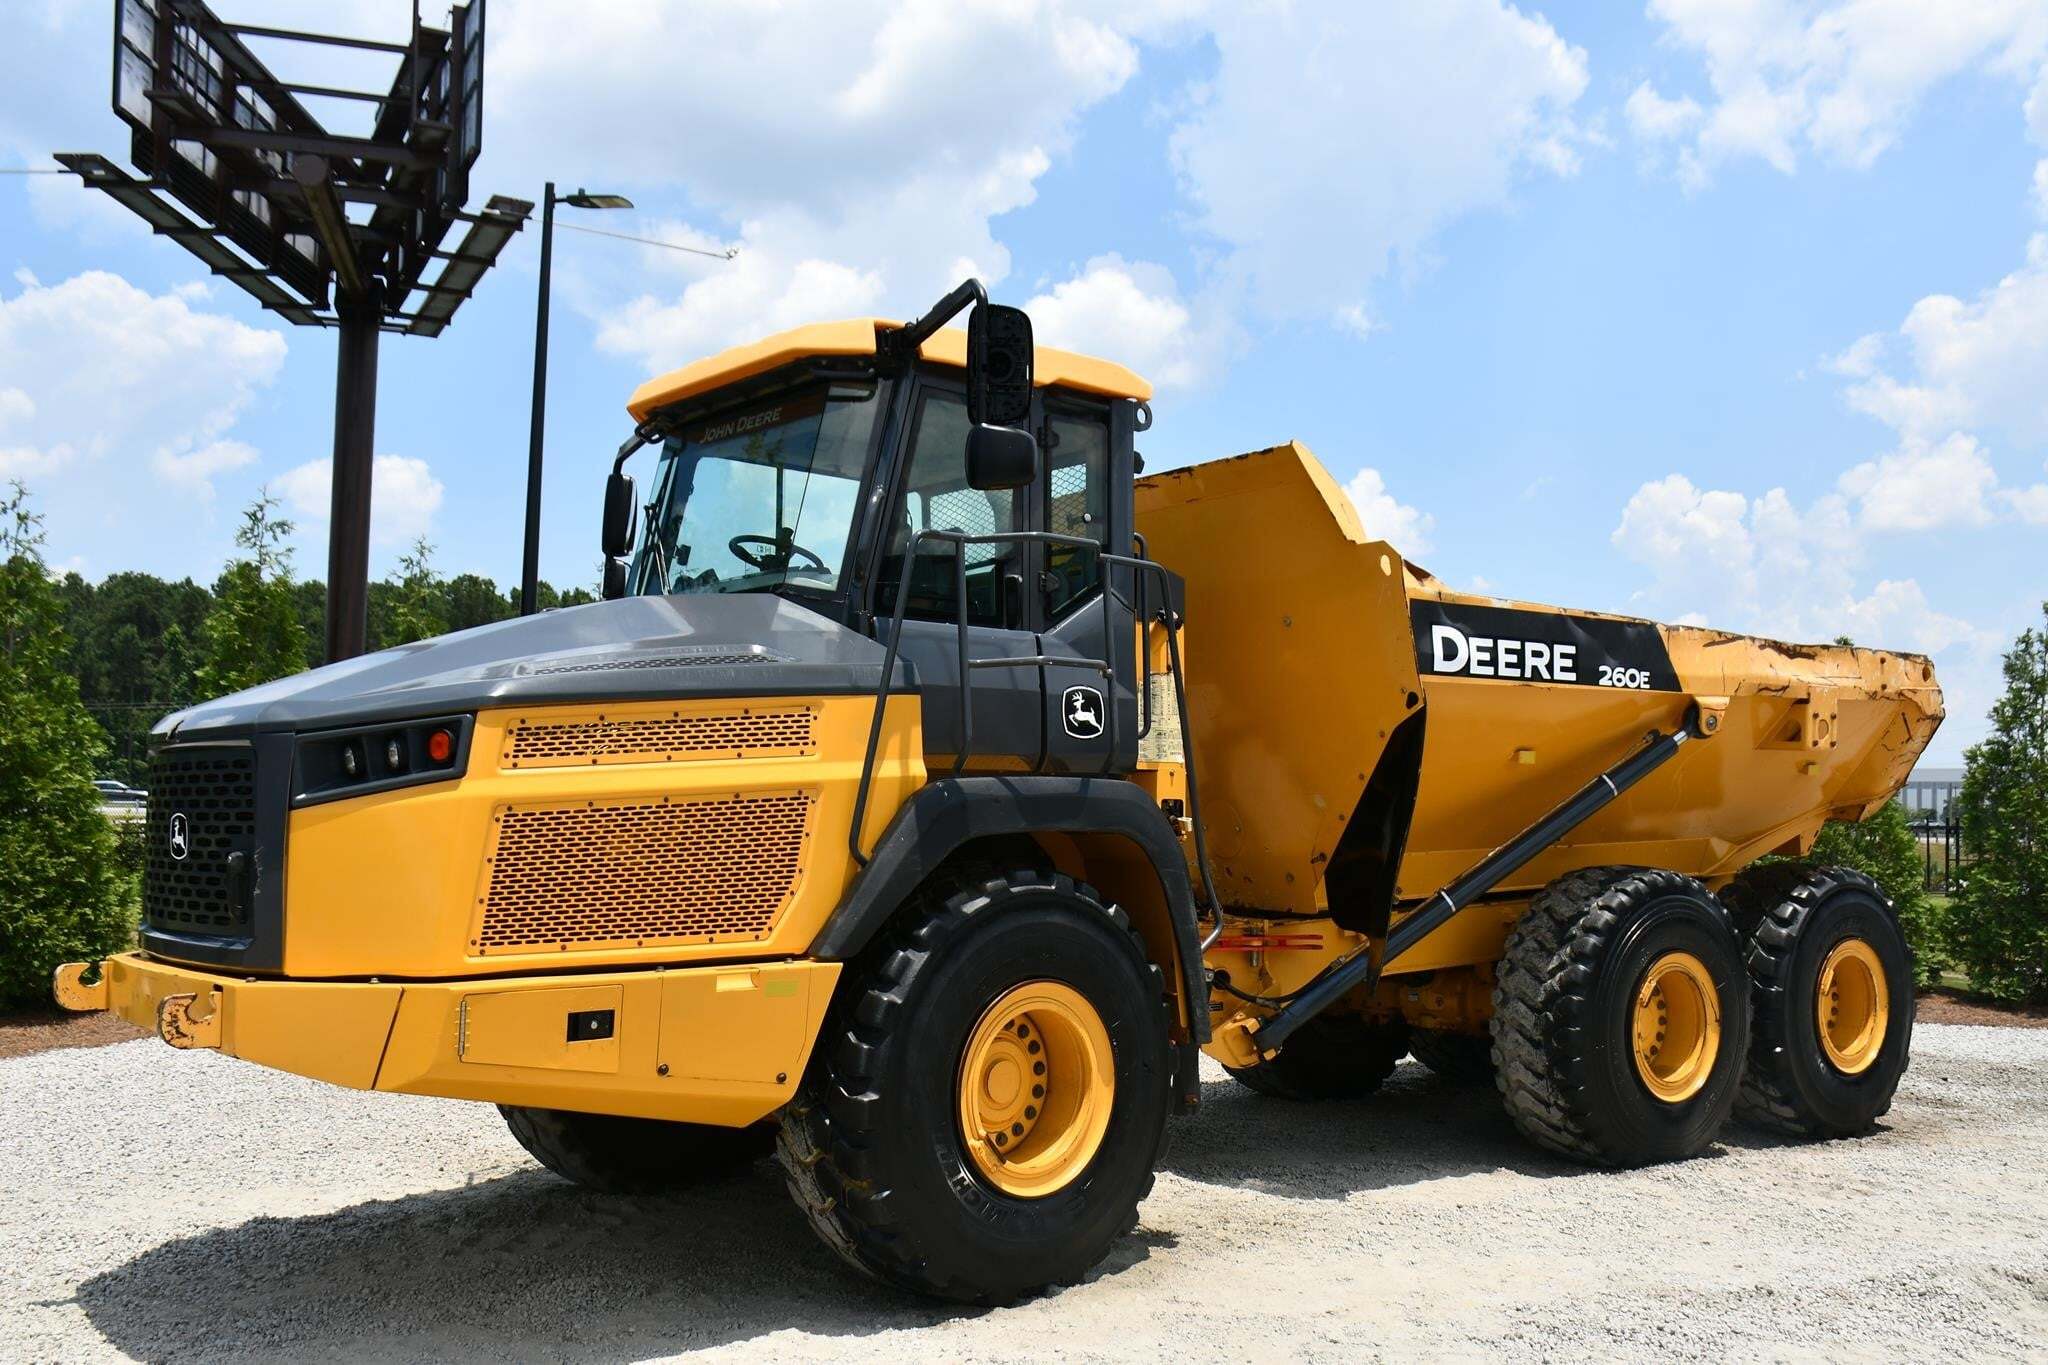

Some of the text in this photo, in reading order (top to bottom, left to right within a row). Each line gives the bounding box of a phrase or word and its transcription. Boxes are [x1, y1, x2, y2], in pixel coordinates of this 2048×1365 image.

[700, 407, 782, 444] JOHN DEERE
[1431, 624, 1650, 689] DEERE 260E
